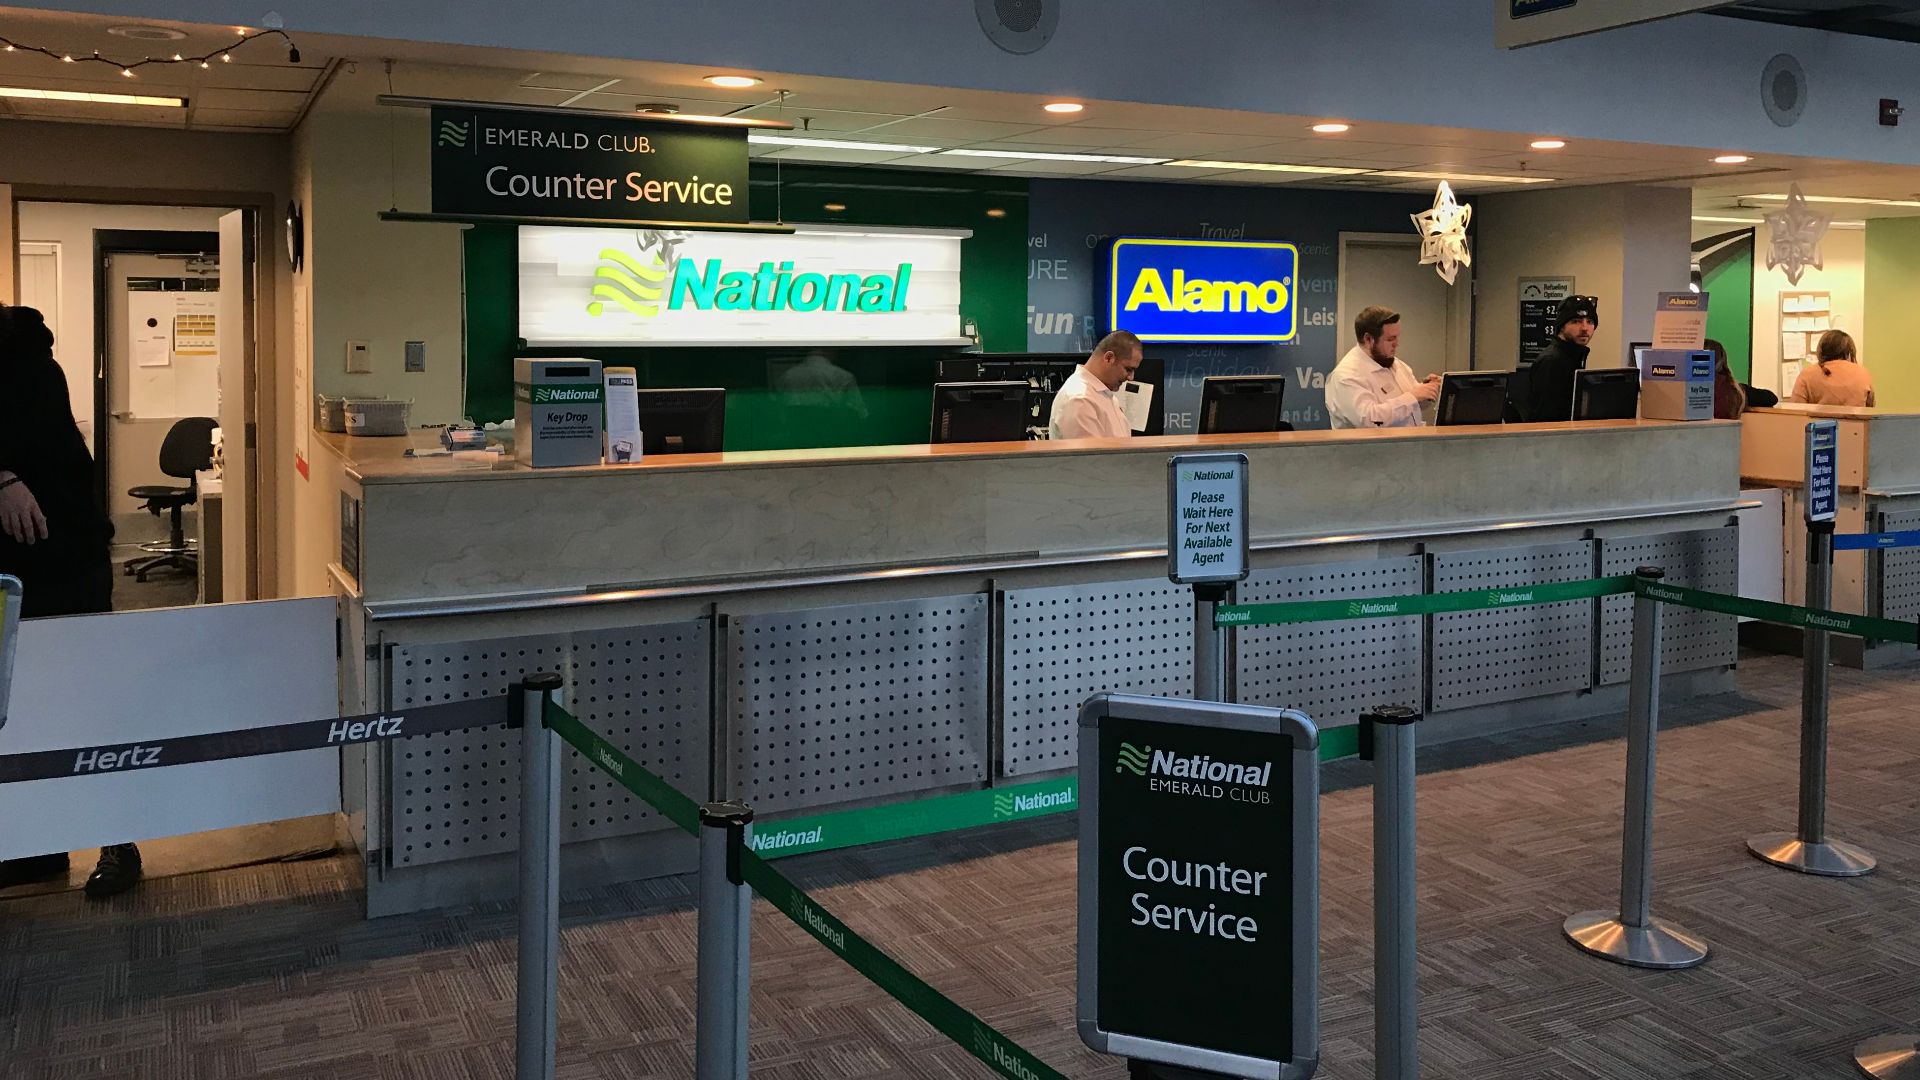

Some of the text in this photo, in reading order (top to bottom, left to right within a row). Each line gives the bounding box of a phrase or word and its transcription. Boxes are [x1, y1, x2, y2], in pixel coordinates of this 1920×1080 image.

[485, 128, 589, 150] EMERALD
[485, 166, 733, 206] Counter Service
[1200, 222, 1245, 240] Travel
[668, 258, 913, 313] National
[1301, 278, 1337, 293] ven
[1544, 283, 1568, 292] Refueling
[1669, 298, 1697, 306] Alamo
[1304, 306, 1338, 326] Leis
[1653, 366, 1675, 375] Alamo
[550, 388, 599, 401] National
[1691, 386, 1710, 395] Key Drop
[547, 411, 588, 425] Key Drop
[1816, 454, 1829, 464] Please
[1194, 470, 1234, 481] National
[1812, 465, 1832, 475] Wait Here
[1821, 476, 1831, 486] Next
[1191, 492, 1225, 503] Please
[1183, 506, 1233, 519] Wait Here
[1815, 500, 1828, 512] Agent
[1186, 521, 1230, 534] For Next
[1184, 536, 1233, 549] Available
[1192, 552, 1225, 566] Agent
[1646, 585, 1683, 601] National
[1805, 613, 1851, 630] National
[328, 714, 405, 744] Hertz
[73, 744, 164, 774] Hertz
[599, 747, 624, 777] National
[1150, 749, 1272, 787] National
[1150, 778, 1271, 805] EMERALD CLUB
[1123, 846, 1268, 897] Counter
[1131, 892, 1258, 943] Service
[804, 904, 848, 952] National
